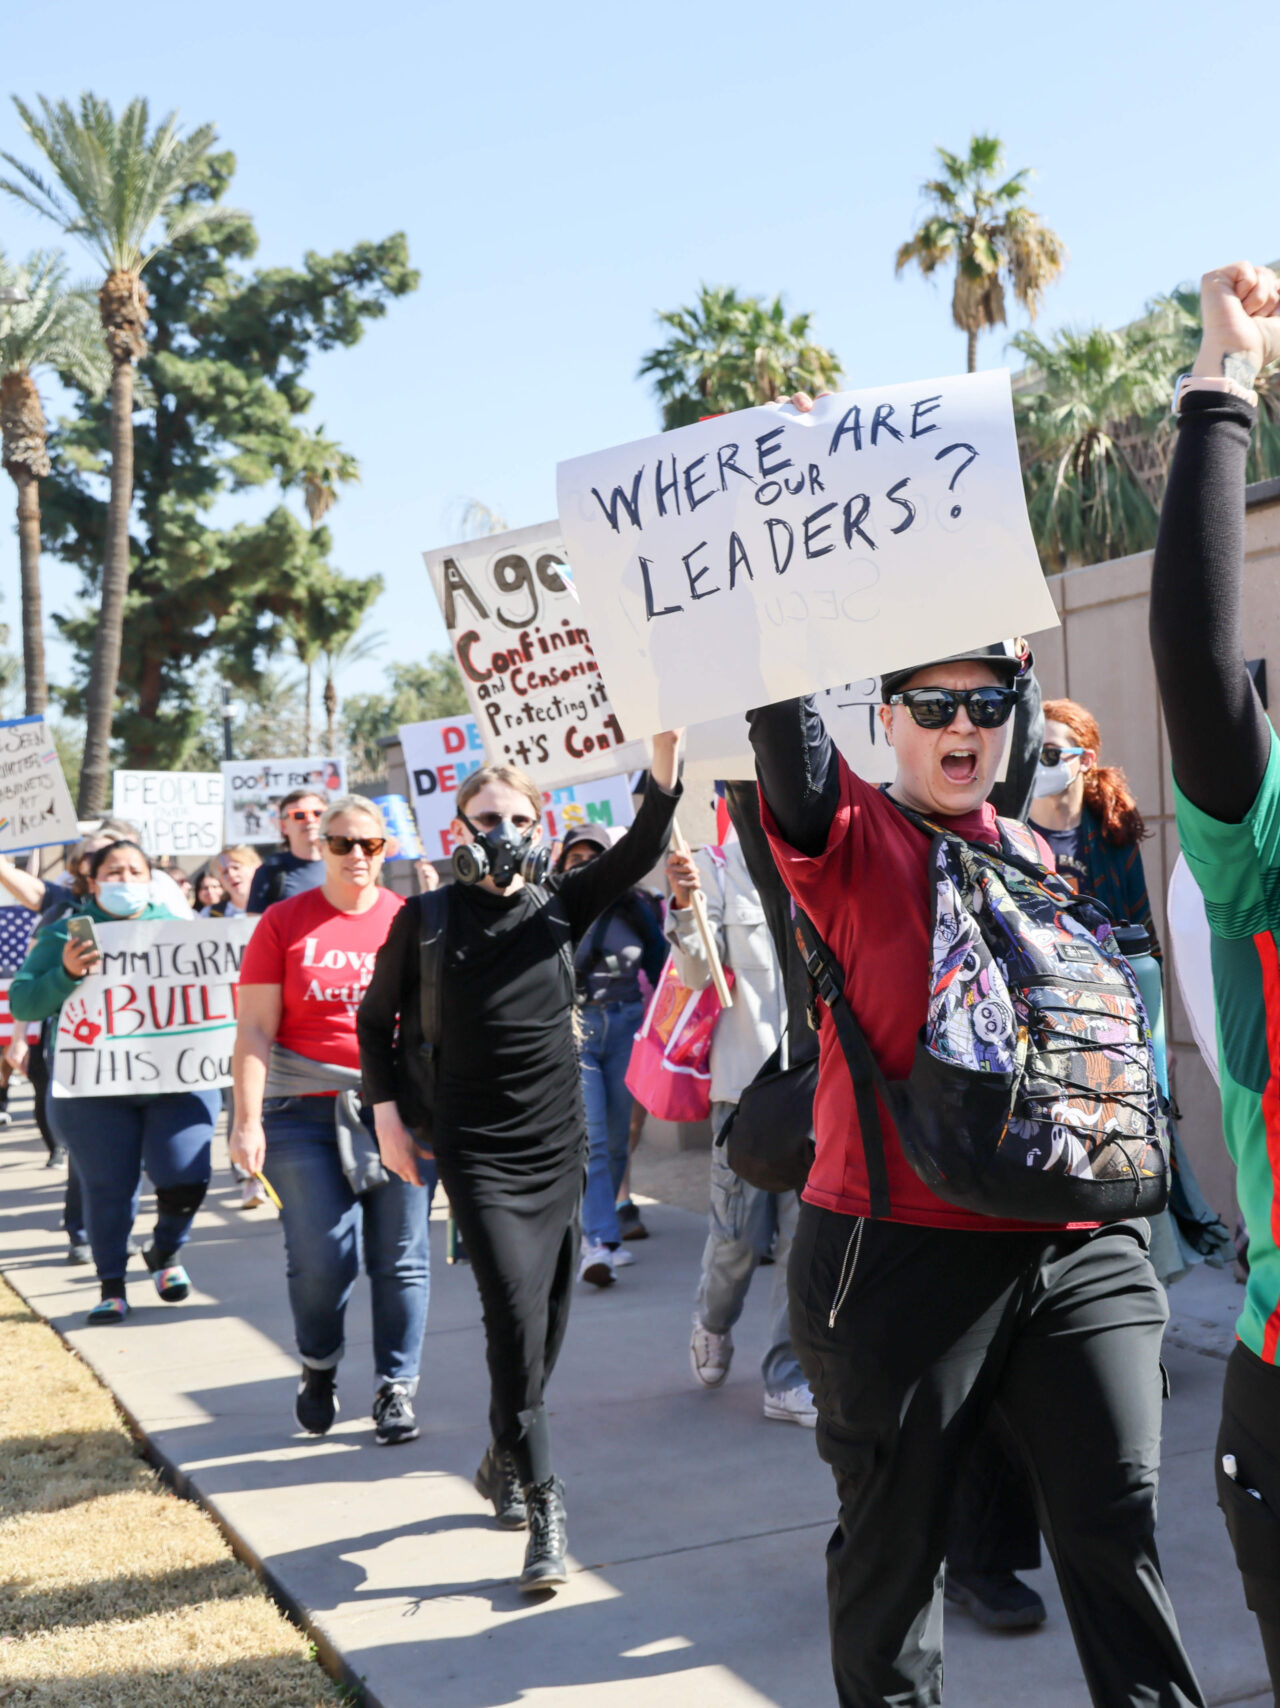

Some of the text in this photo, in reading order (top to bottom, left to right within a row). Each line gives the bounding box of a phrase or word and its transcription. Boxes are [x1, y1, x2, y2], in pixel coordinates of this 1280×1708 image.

[591, 425, 794, 534] WHERE
[829, 394, 943, 456] ARE
[755, 463, 825, 505] OUR
[485, 696, 588, 737] Protecting
[123, 774, 224, 805] PEOPLE
[59, 1047, 160, 1086] THIS
